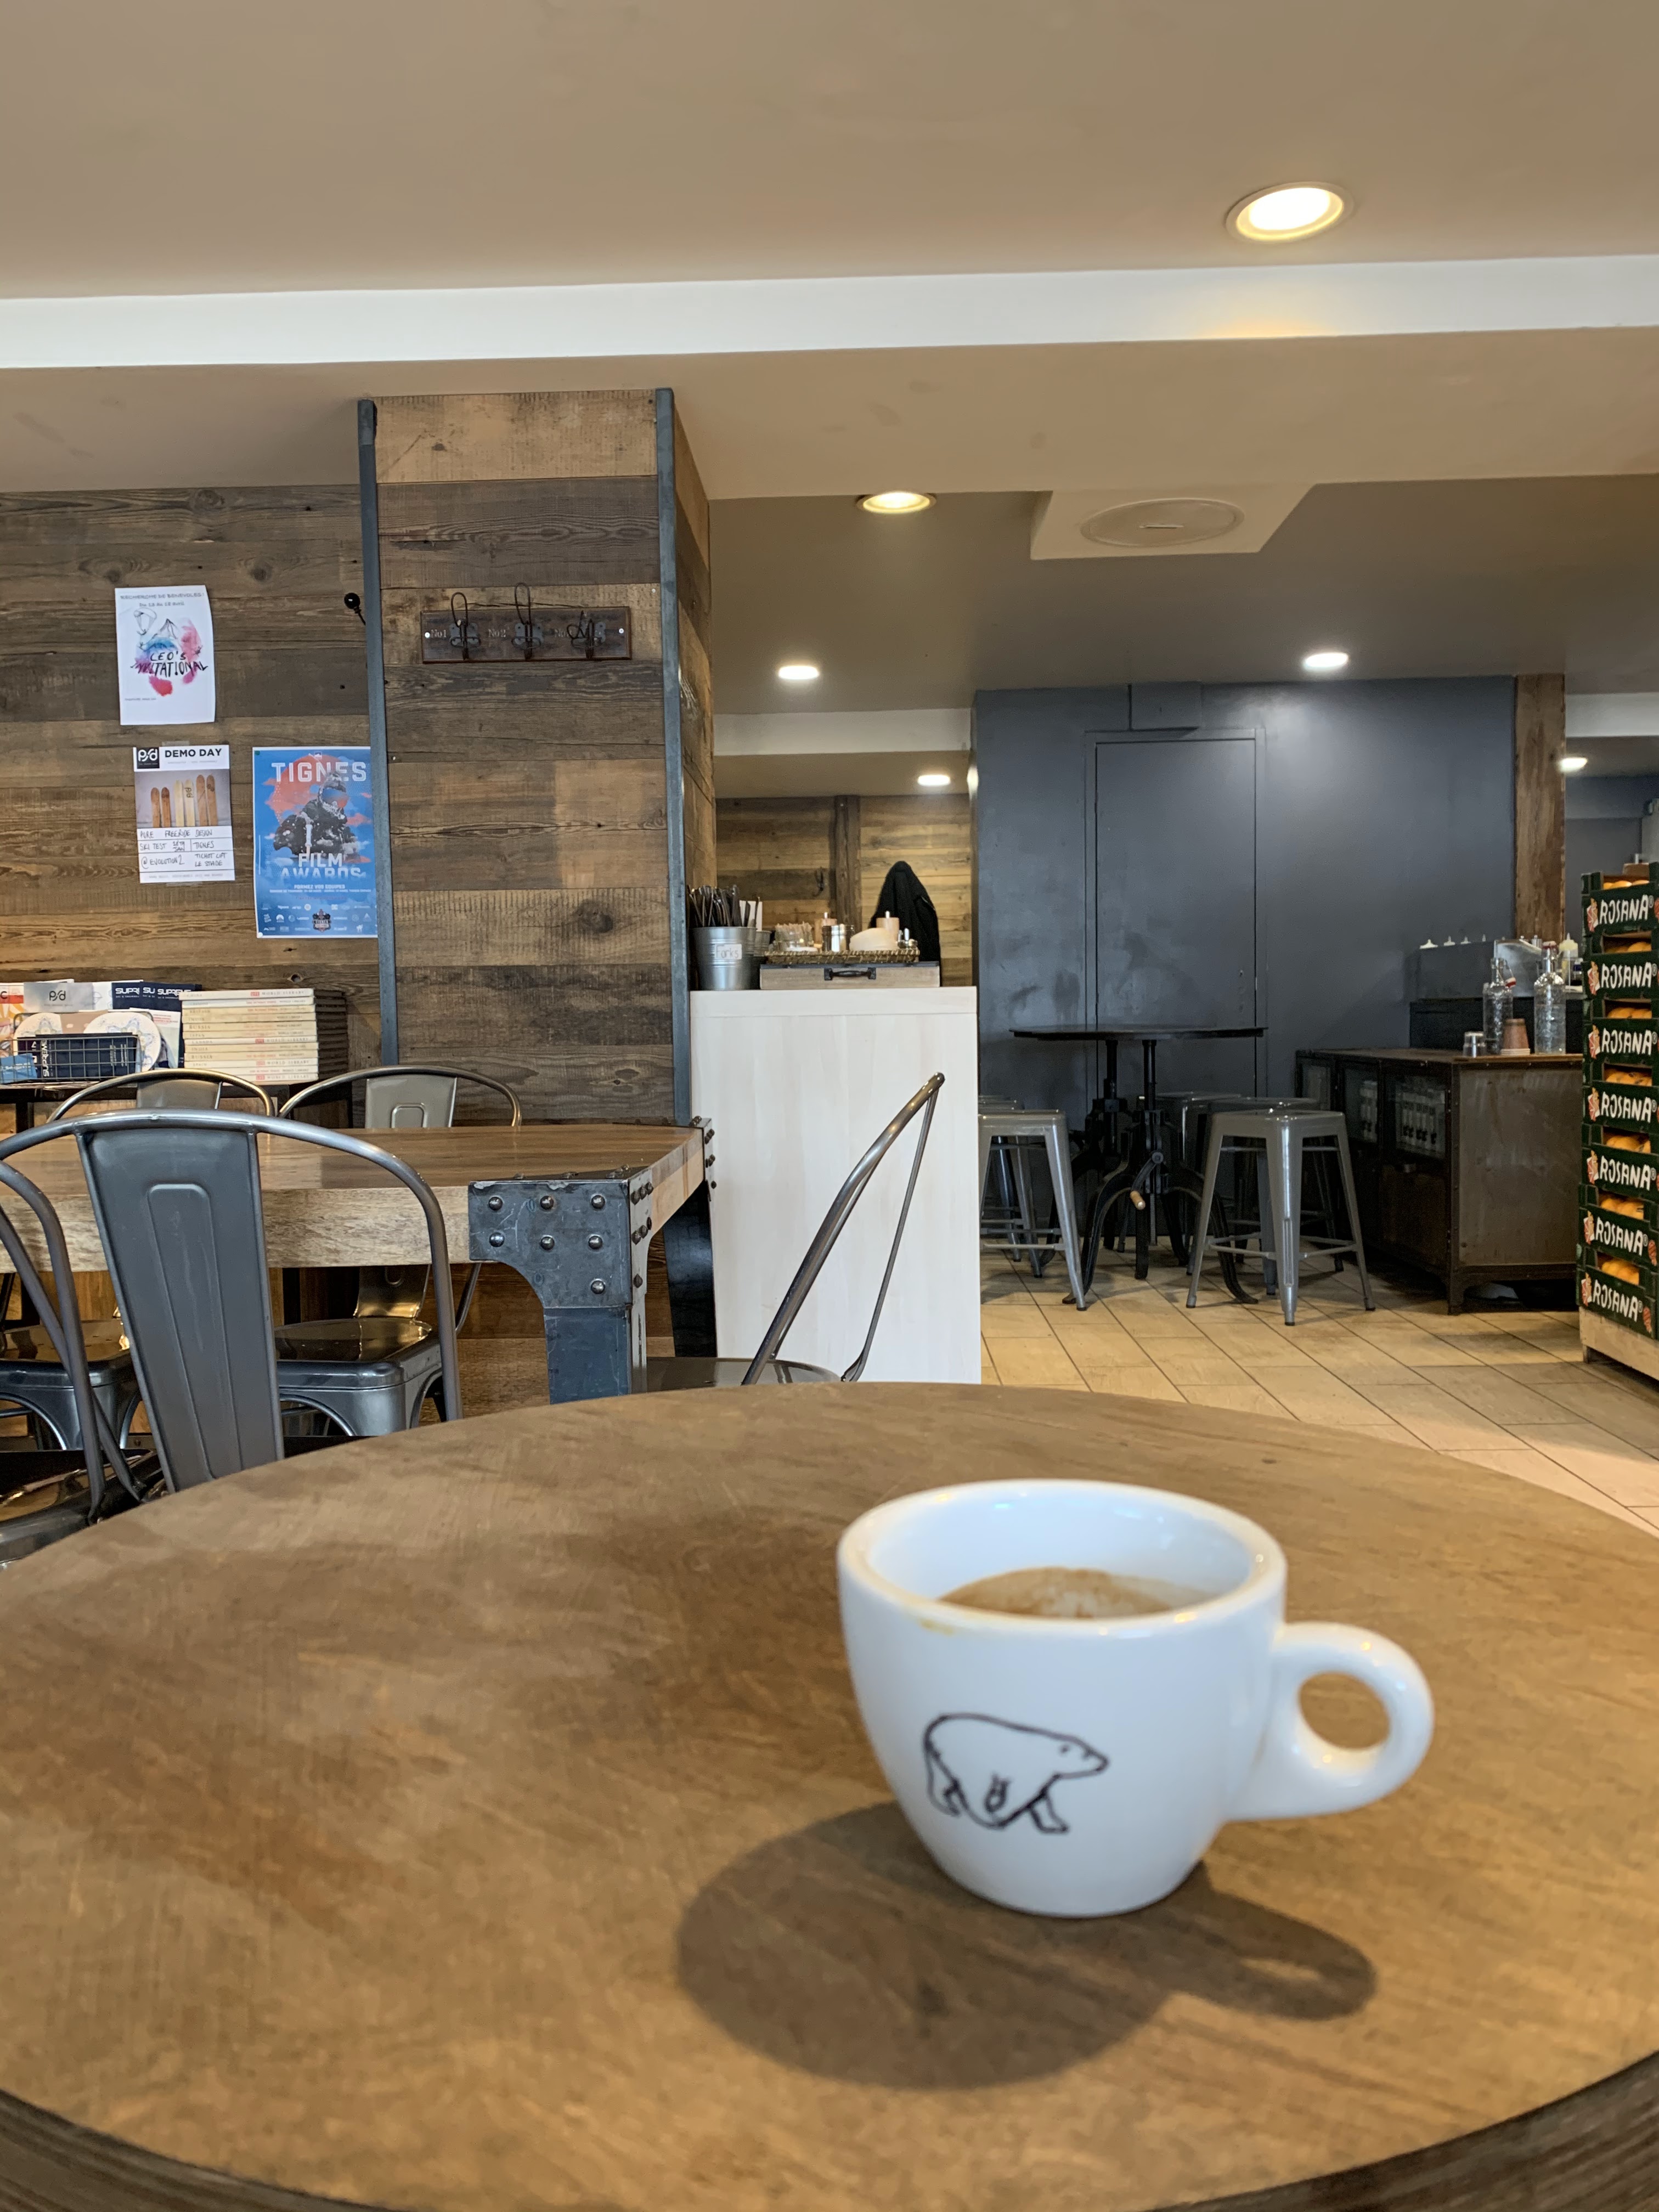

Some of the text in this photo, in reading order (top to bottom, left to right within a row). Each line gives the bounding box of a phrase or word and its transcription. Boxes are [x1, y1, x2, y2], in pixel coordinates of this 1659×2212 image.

[150, 651, 187, 662] LEO'S
[165, 748, 222, 758] DEMO DAY
[271, 761, 367, 782] TIGNES
[298, 853, 342, 868] FILM
[280, 867, 363, 879] AWARDS
[716, 944, 739, 959] Forks
